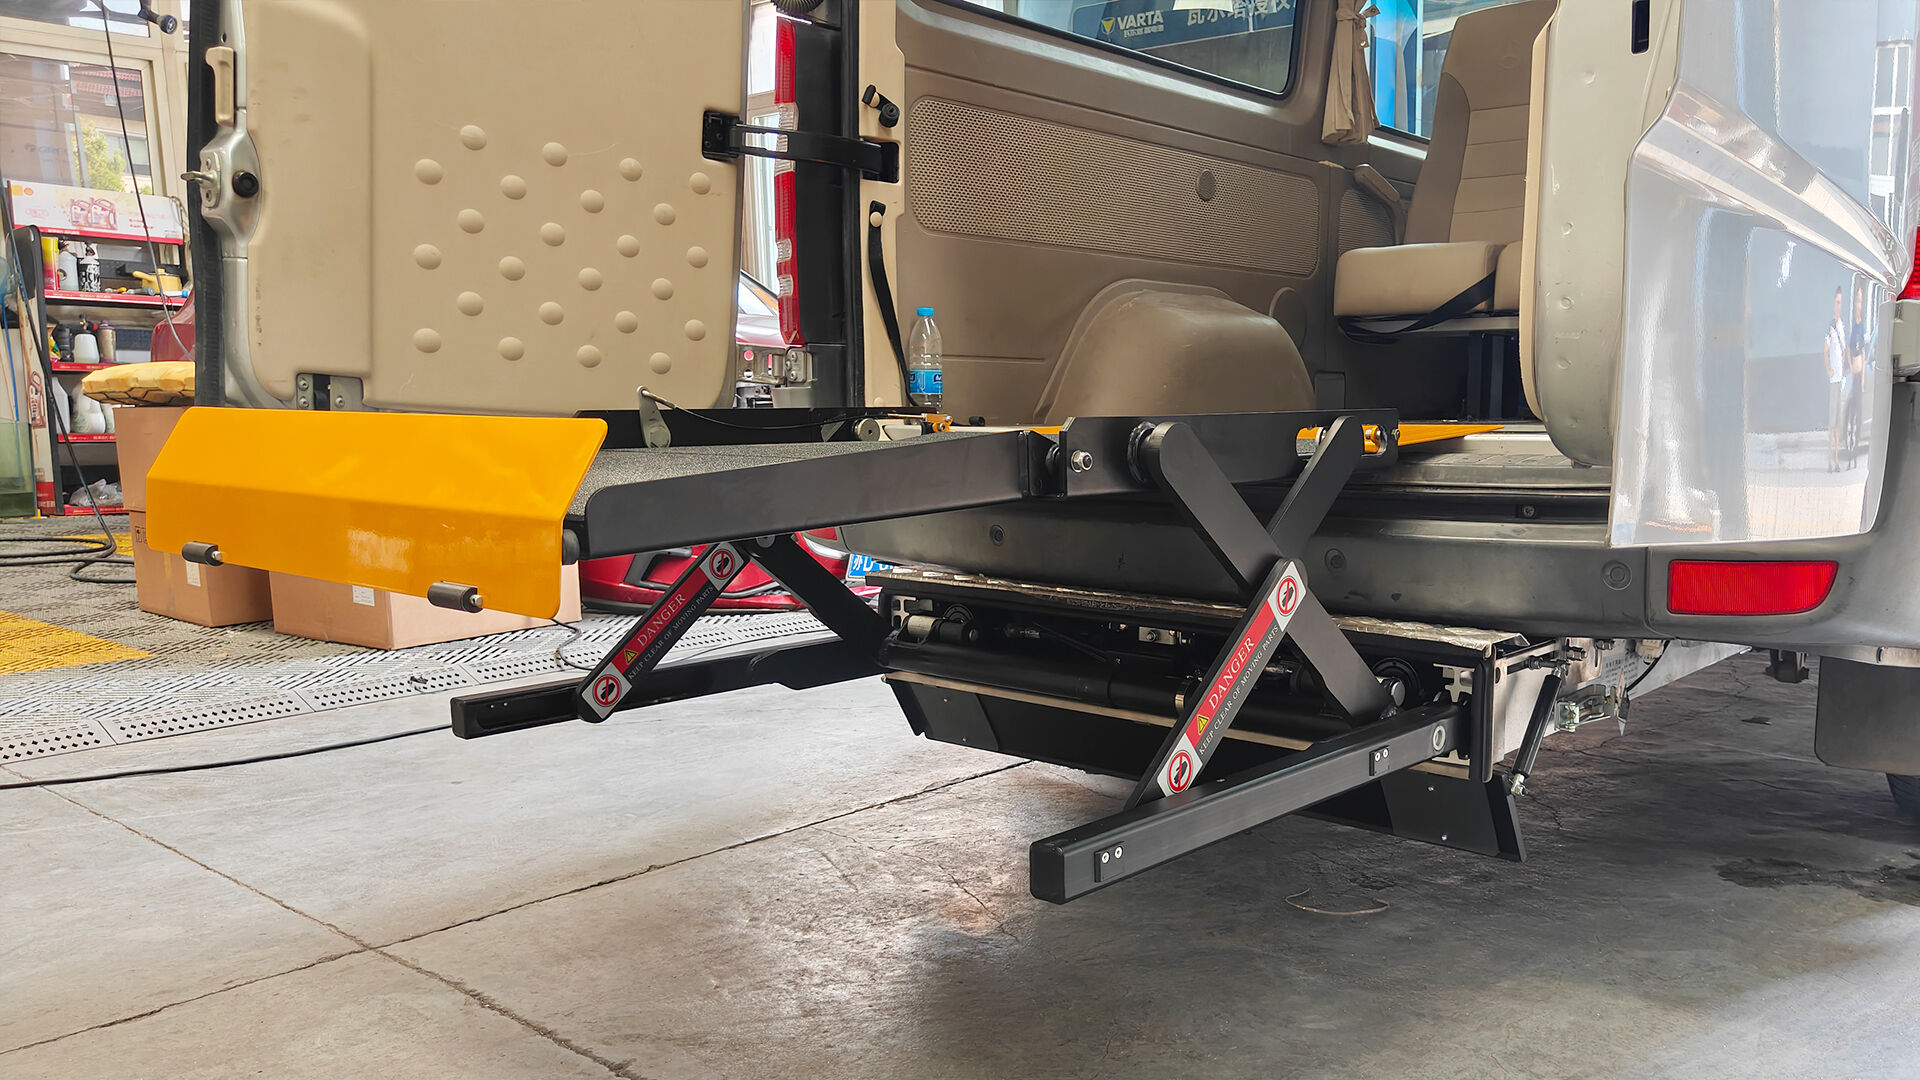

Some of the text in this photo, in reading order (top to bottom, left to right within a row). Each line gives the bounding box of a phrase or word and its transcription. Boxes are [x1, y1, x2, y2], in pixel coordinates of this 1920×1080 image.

[1117, 10, 1164, 30] VARTA
[628, 586, 714, 680] KEEP CLEAR OF MOVING PARTS
[637, 593, 686, 647] DANGER
[1198, 624, 1279, 755] KEEP CLEAR OF MOVING PARTS
[1208, 637, 1255, 710] DANGER
